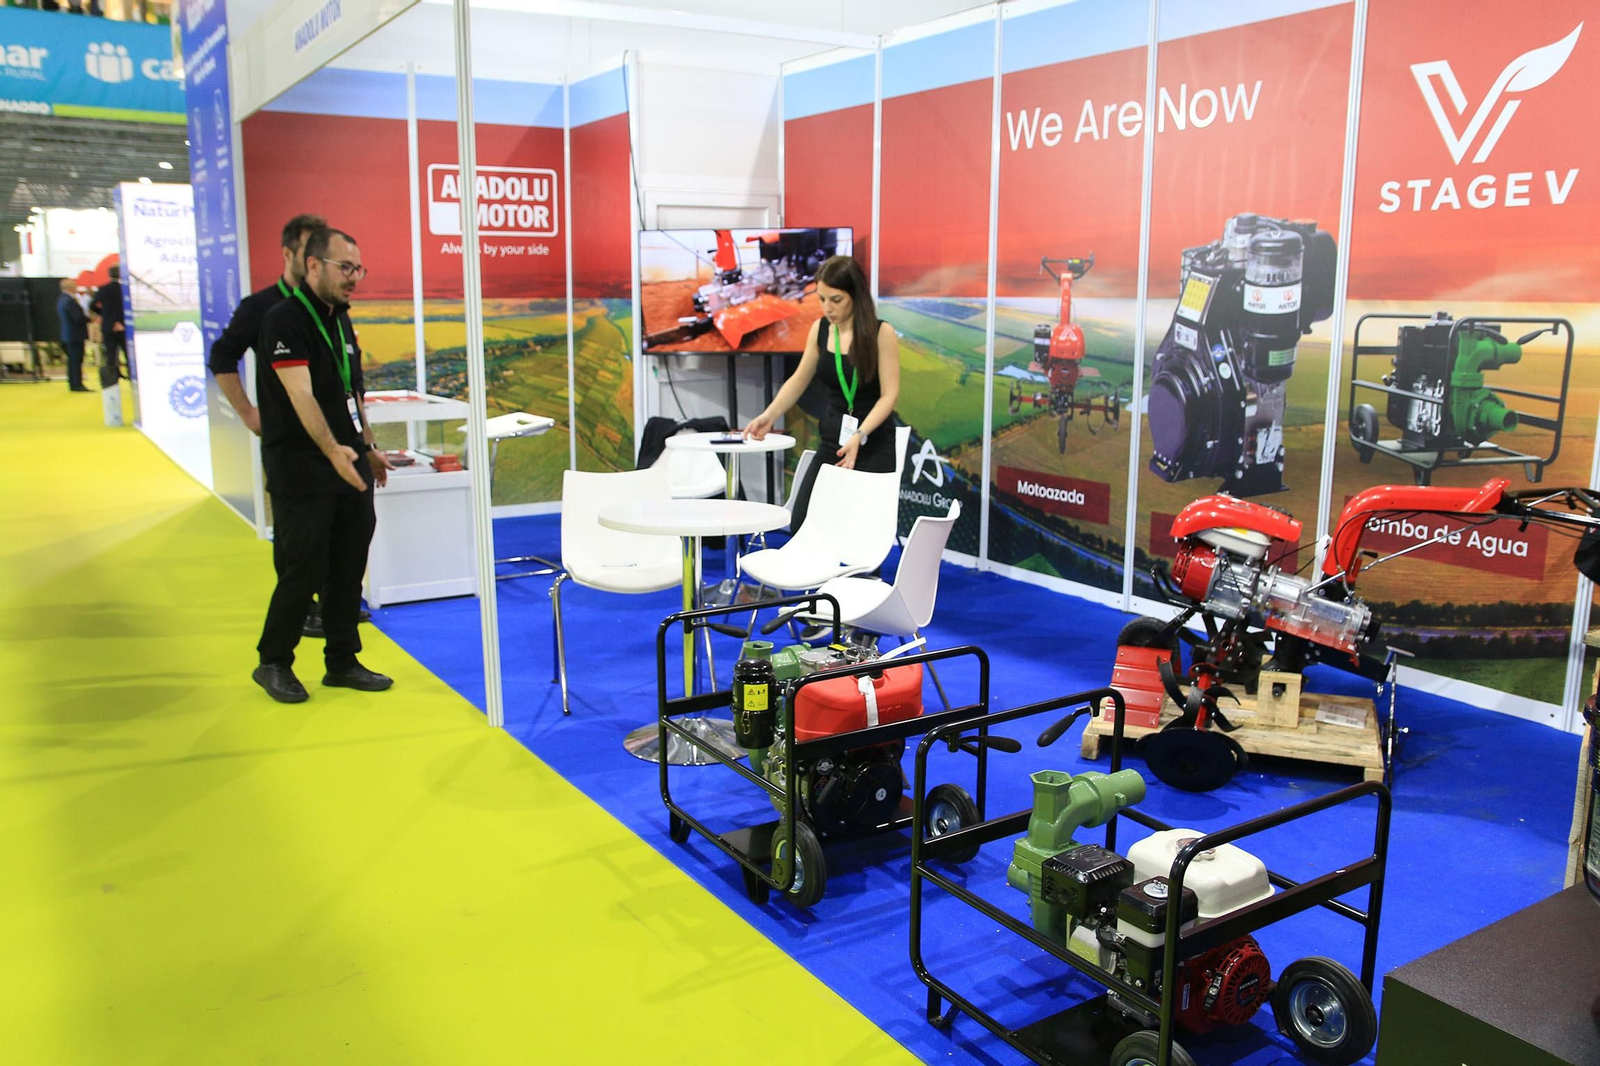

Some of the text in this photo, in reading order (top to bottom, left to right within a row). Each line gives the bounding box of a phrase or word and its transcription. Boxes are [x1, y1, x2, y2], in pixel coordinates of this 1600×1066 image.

[1006, 80, 1263, 151] We Are Now
[440, 174, 549, 202] AADOLU
[1378, 168, 1580, 213] STAGE V
[483, 243, 498, 257] by
[500, 245, 525, 257] your
[527, 244, 550, 256] side
[899, 489, 931, 505] NADOLU
[1017, 479, 1085, 505] Motoazada
[1365, 516, 1528, 558] omba de Agua
